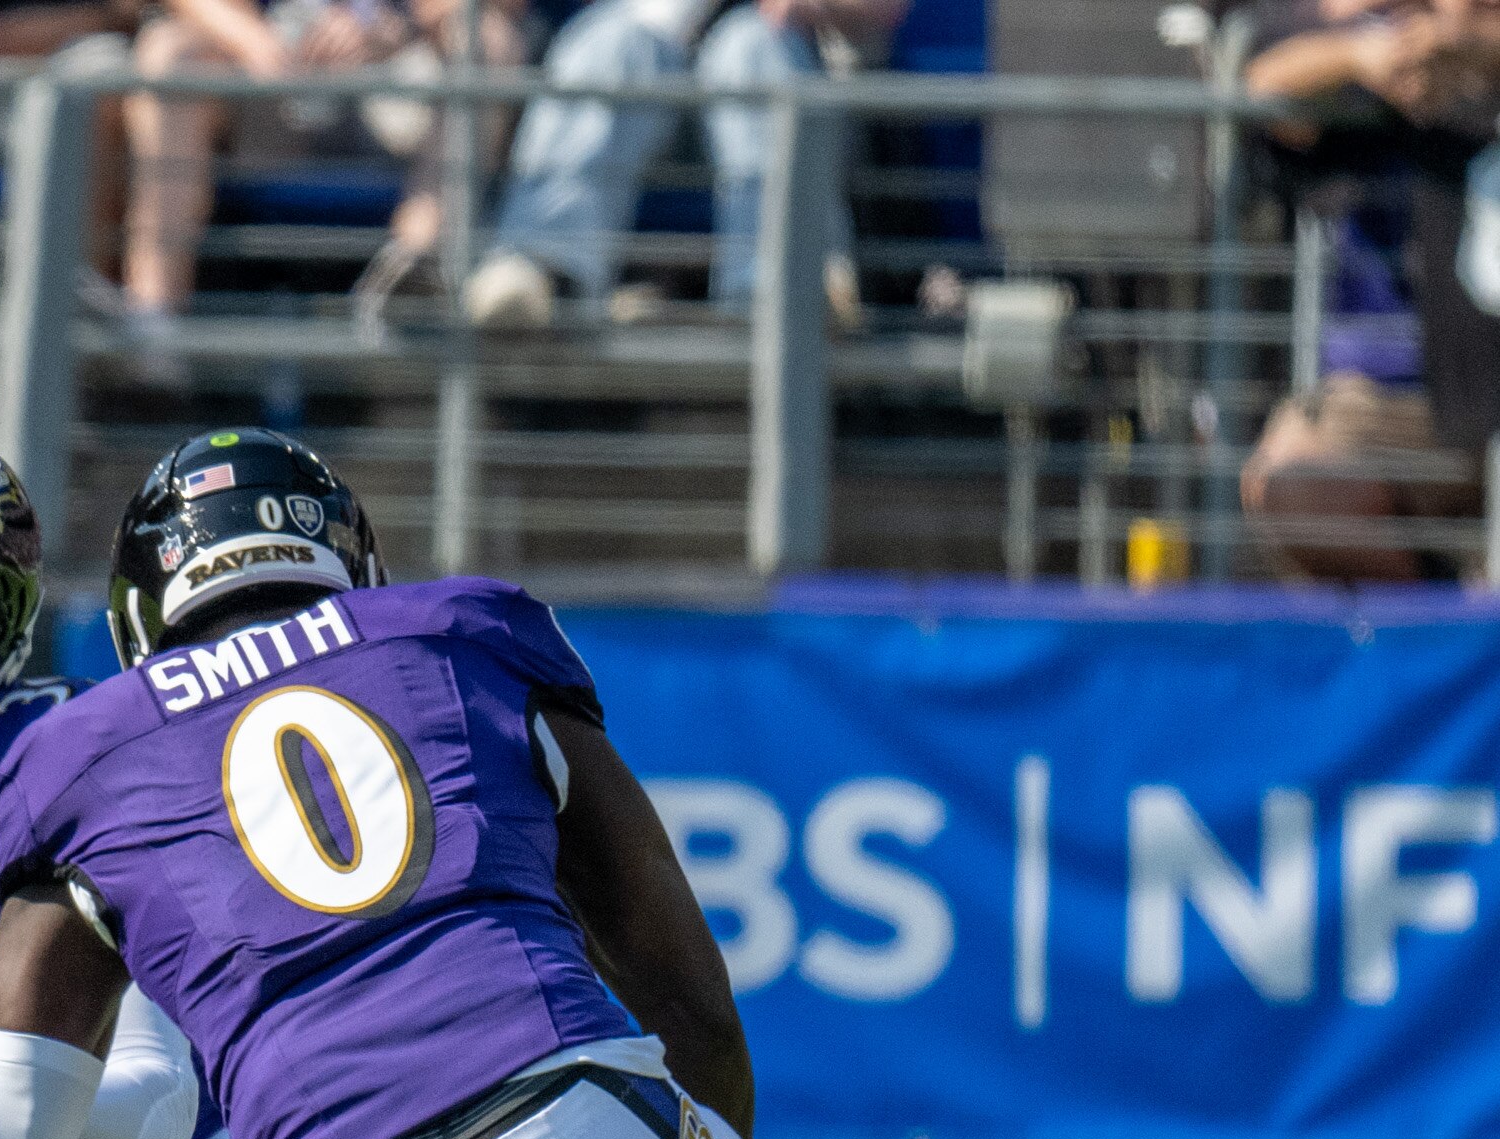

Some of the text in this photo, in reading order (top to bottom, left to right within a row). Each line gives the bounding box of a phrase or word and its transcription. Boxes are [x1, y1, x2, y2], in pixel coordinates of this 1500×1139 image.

[184, 544, 315, 592] RAVENS
[257, 497, 283, 532] 0
[146, 598, 354, 713] SMITH
[220, 683, 425, 917] 0
[640, 777, 1498, 1005] BS NF
